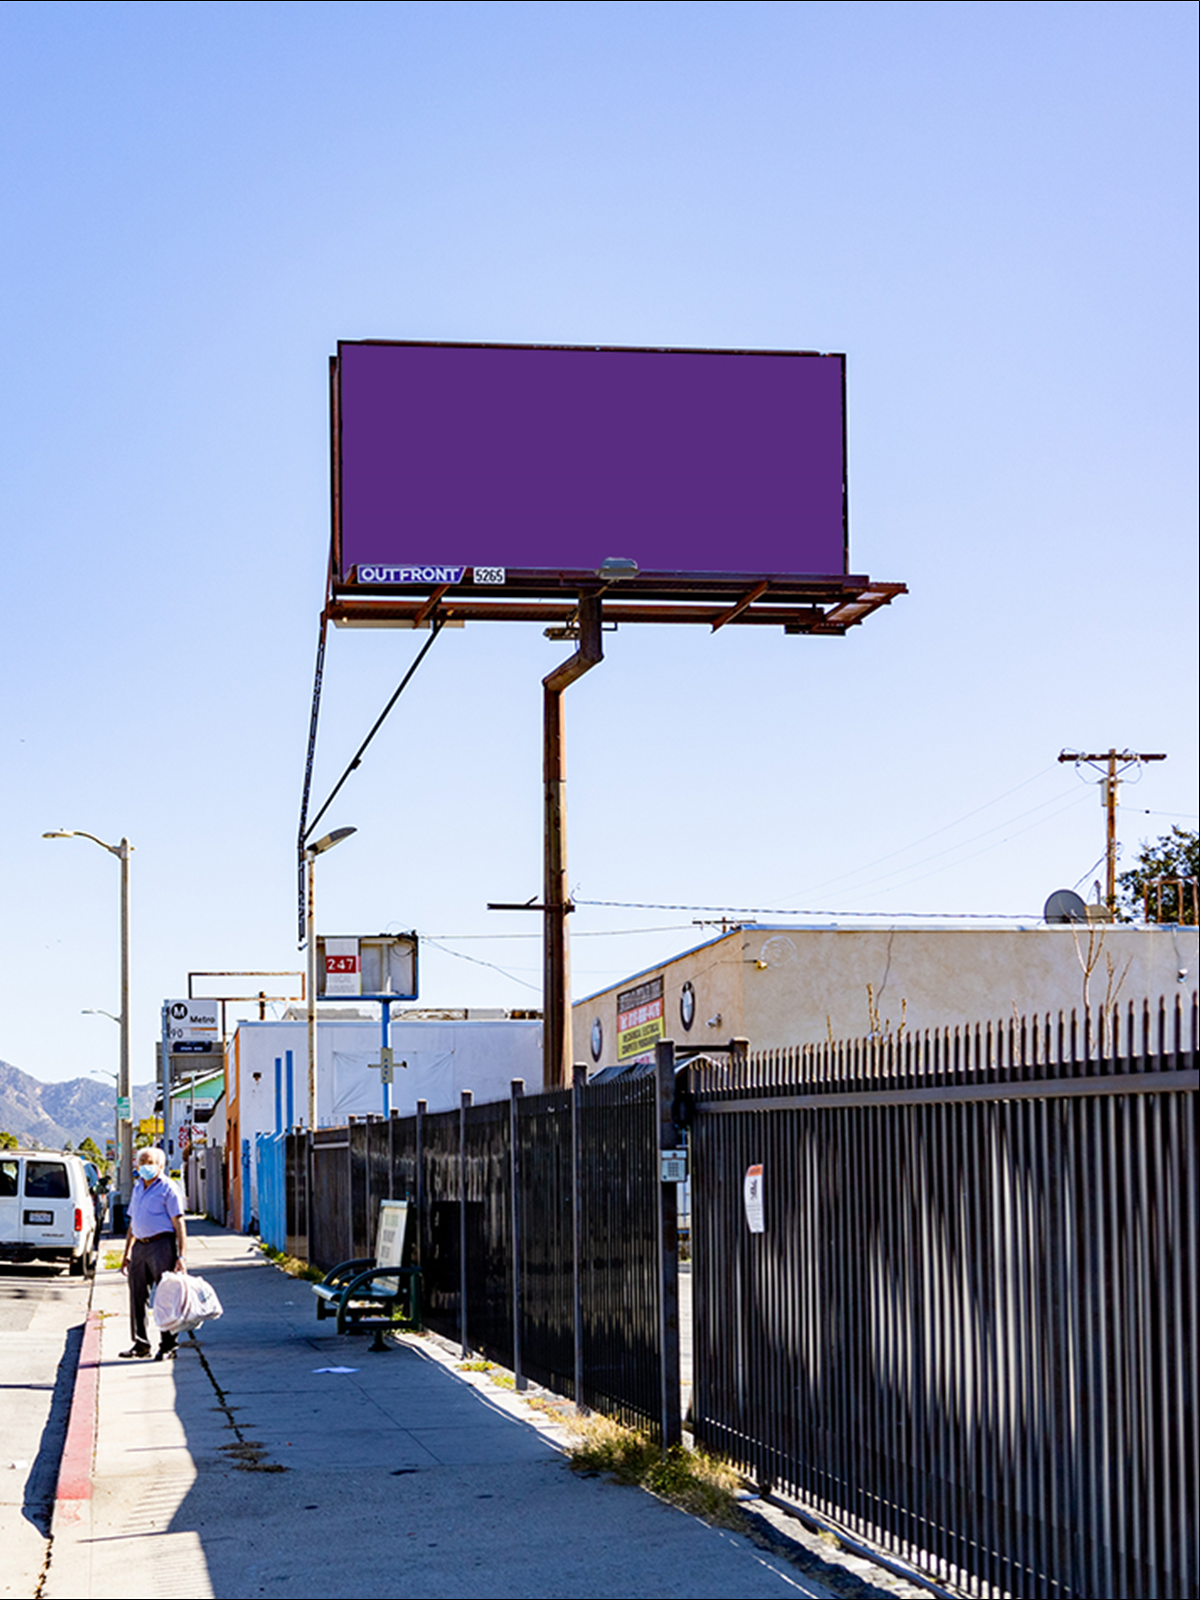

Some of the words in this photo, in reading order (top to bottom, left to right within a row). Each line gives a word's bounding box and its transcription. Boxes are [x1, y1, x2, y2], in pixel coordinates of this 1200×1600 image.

[360, 567, 460, 582] OUTFRONT
[474, 568, 504, 582] 5265
[327, 958, 354, 970] 247
[189, 1015, 216, 1024] Metro
